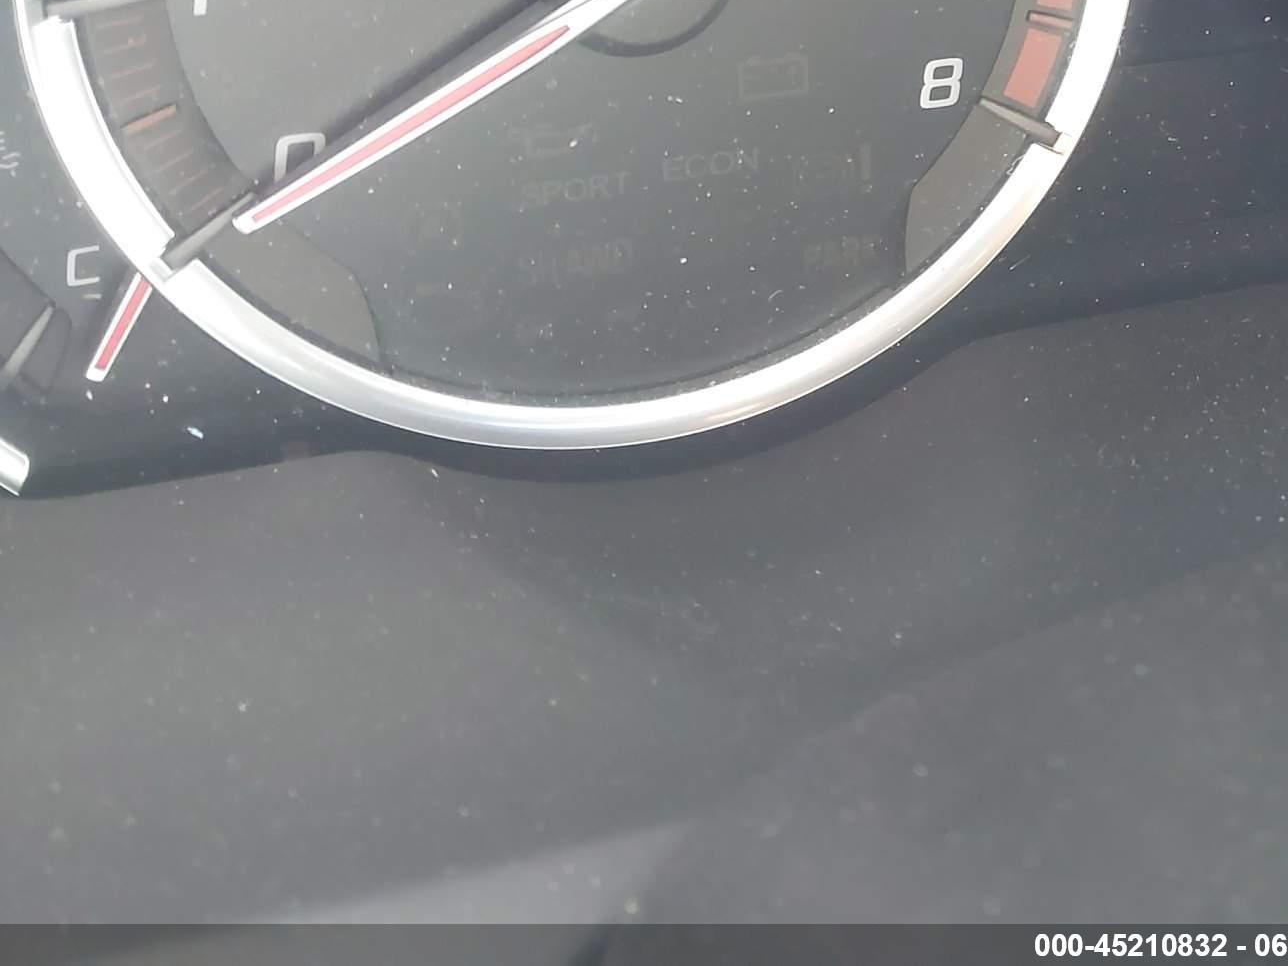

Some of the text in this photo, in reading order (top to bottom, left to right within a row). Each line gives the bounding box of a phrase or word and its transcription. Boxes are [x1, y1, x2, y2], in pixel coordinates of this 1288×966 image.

[919, 56, 963, 110] 8
[661, 147, 760, 182] ECON
[66, 245, 101, 287] C
